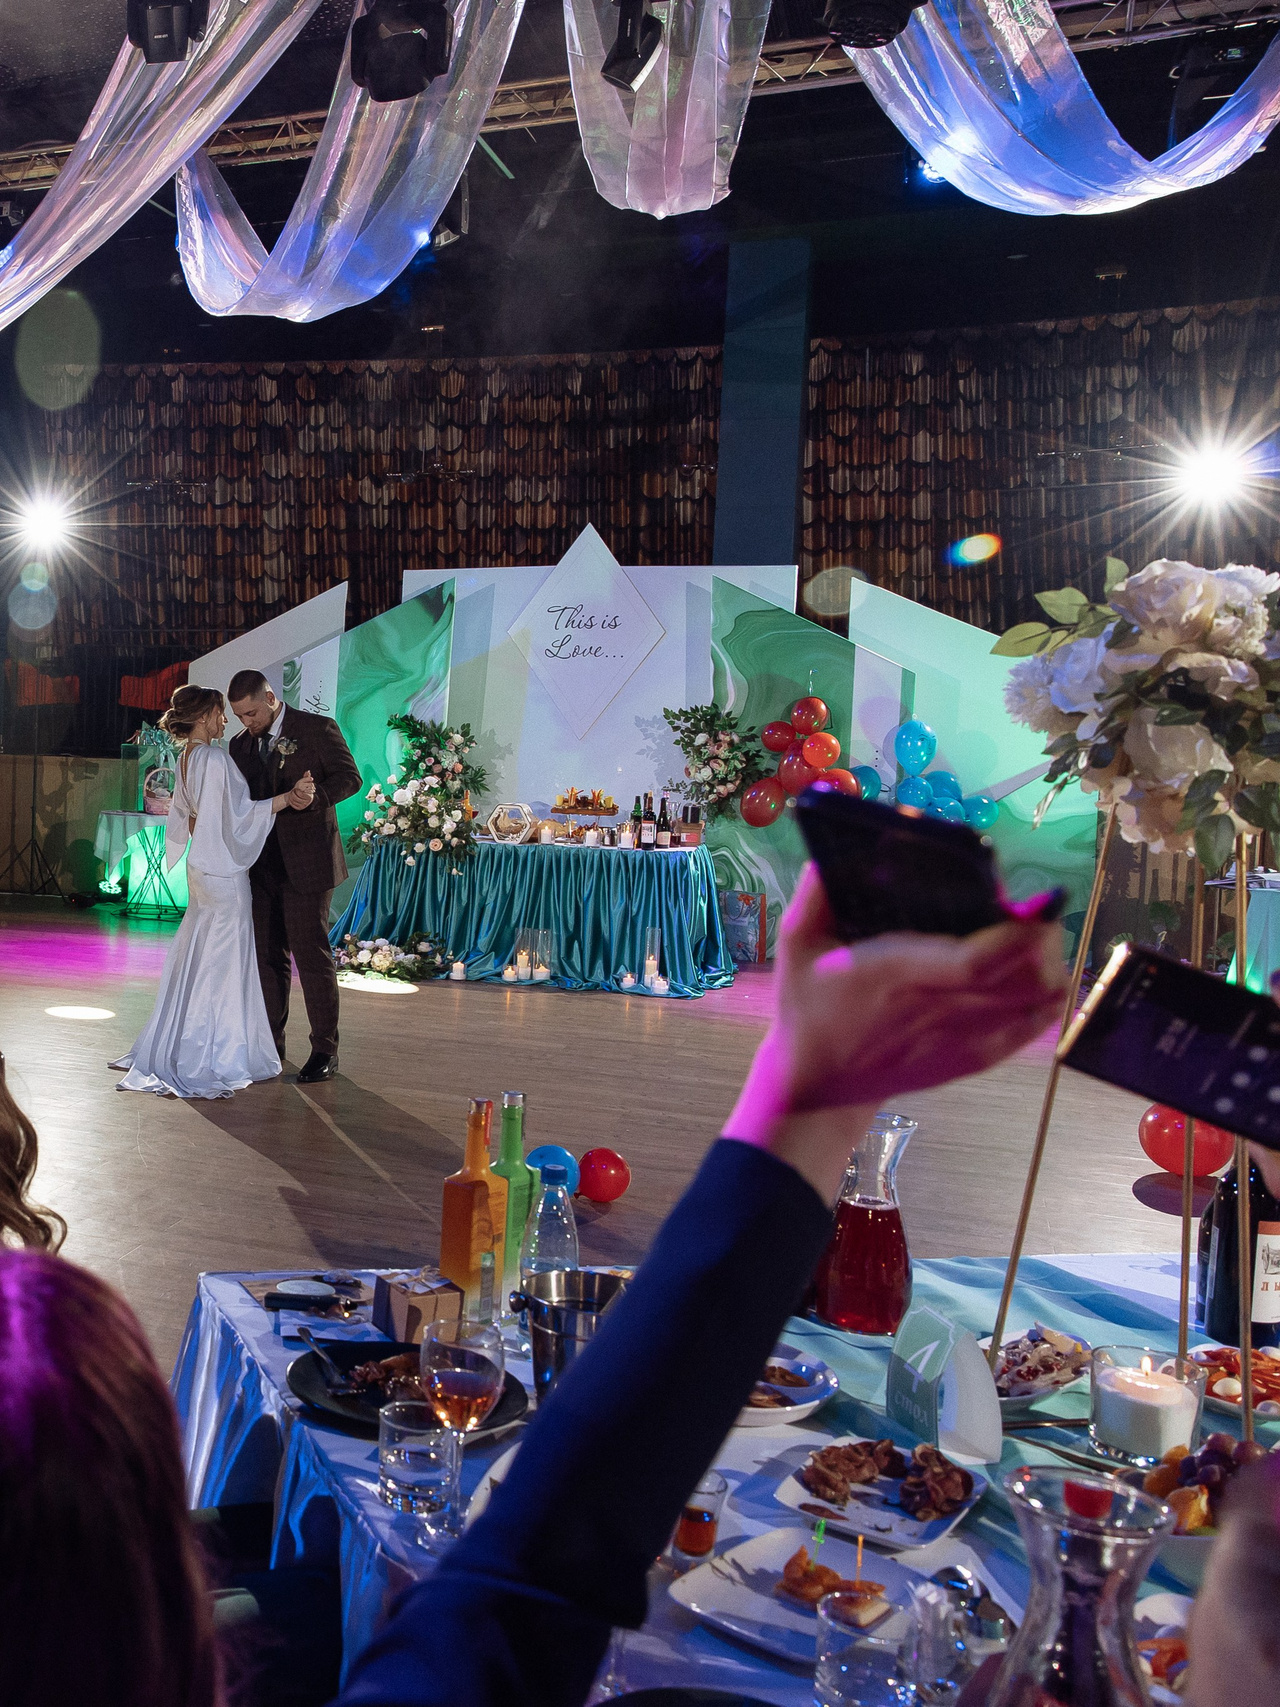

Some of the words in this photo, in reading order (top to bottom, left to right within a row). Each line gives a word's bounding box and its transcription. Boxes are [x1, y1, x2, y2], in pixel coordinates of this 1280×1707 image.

[547, 604, 597, 631] This
[602, 614, 621, 630] is
[544, 634, 624, 660] Love...
[303, 680, 330, 714] ife...
